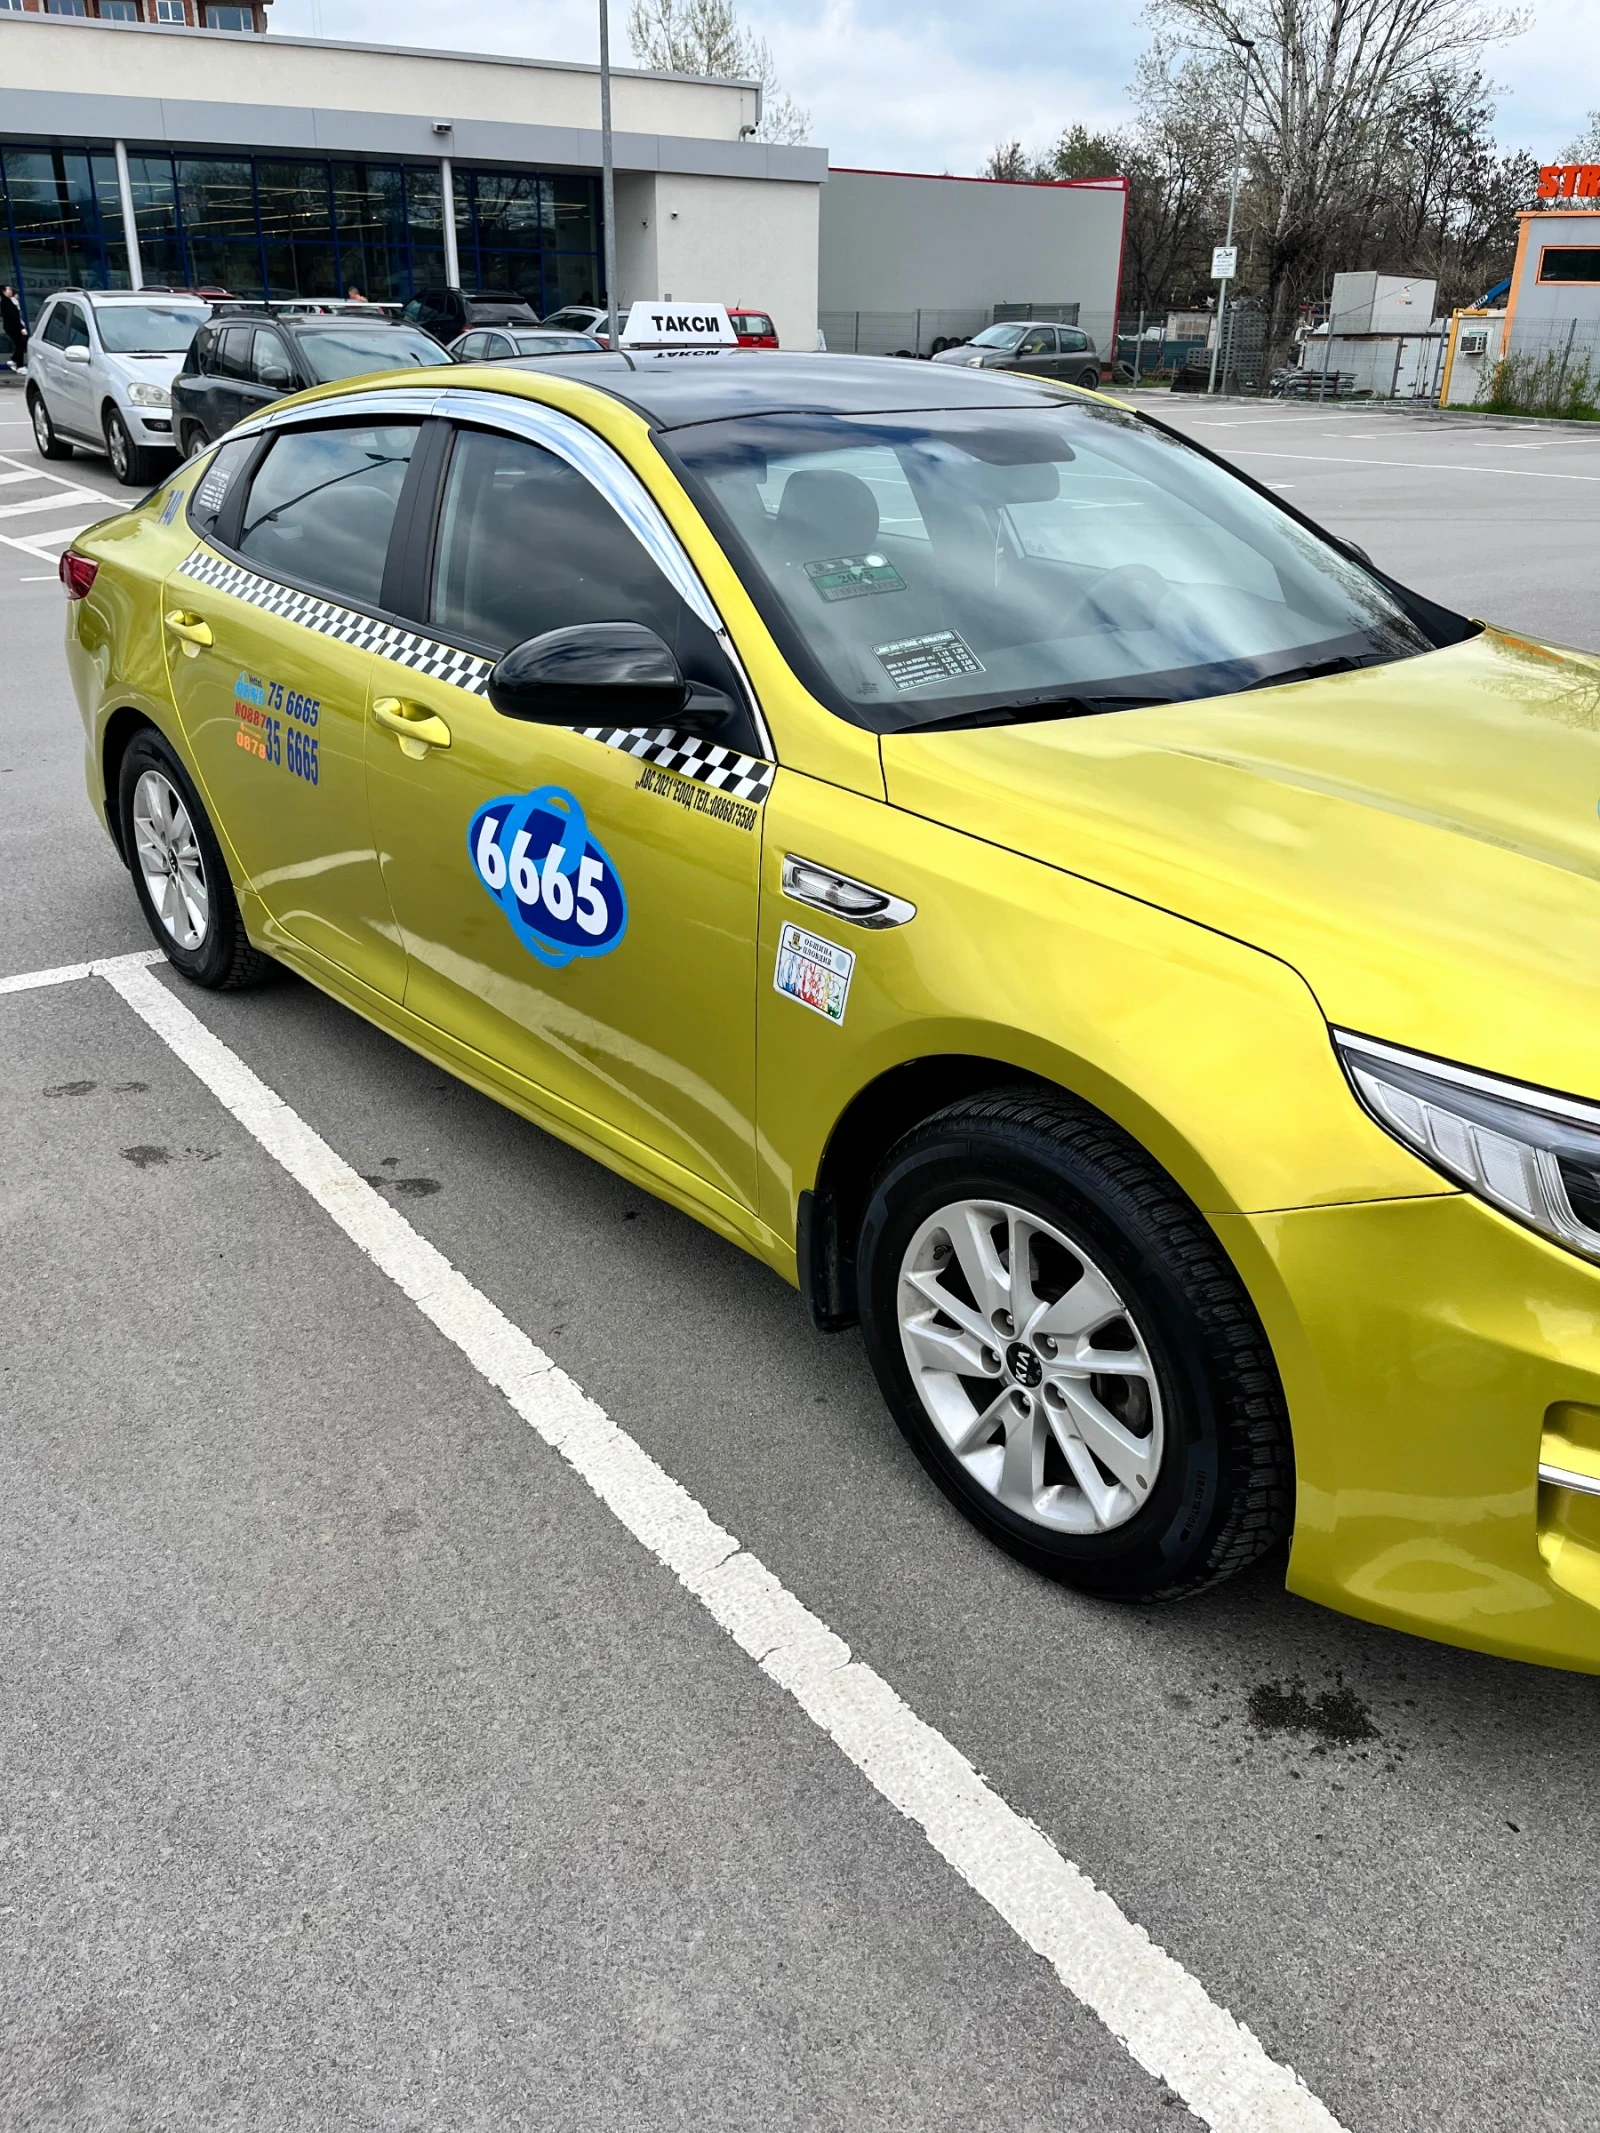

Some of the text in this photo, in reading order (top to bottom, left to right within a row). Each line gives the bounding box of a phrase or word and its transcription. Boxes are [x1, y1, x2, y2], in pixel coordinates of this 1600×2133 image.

[651, 315, 720, 332] ТАКСИ
[234, 679, 320, 727] 0895 75 6665
[236, 731, 266, 760] 0878
[265, 716, 318, 786] 35 6665
[477, 815, 609, 936] 6665
[802, 946, 832, 966] ПЛОВДИВ
[804, 938, 832, 957] ОБЩИНА
[1015, 1351, 1030, 1384] KIA
